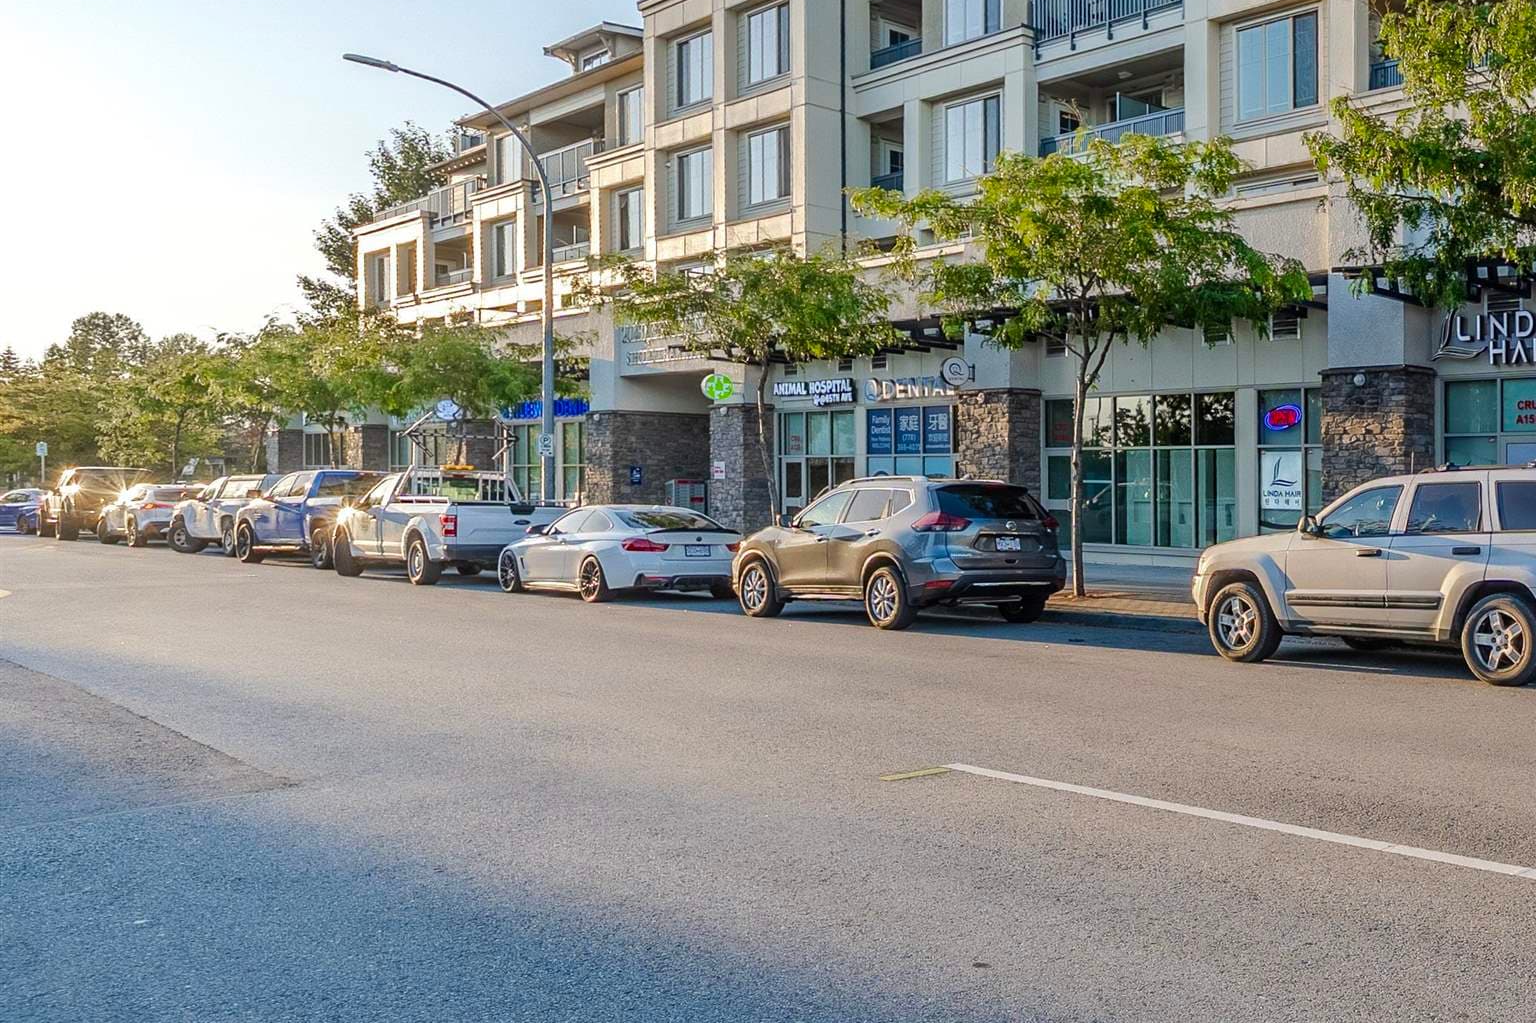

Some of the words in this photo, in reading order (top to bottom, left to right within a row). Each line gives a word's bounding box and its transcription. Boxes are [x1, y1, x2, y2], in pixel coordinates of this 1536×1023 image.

[773, 381, 808, 396] ANIMAL
[809, 378, 853, 394] HOSPITAL
[871, 415, 890, 426] Family
[871, 426, 891, 434] Dentist
